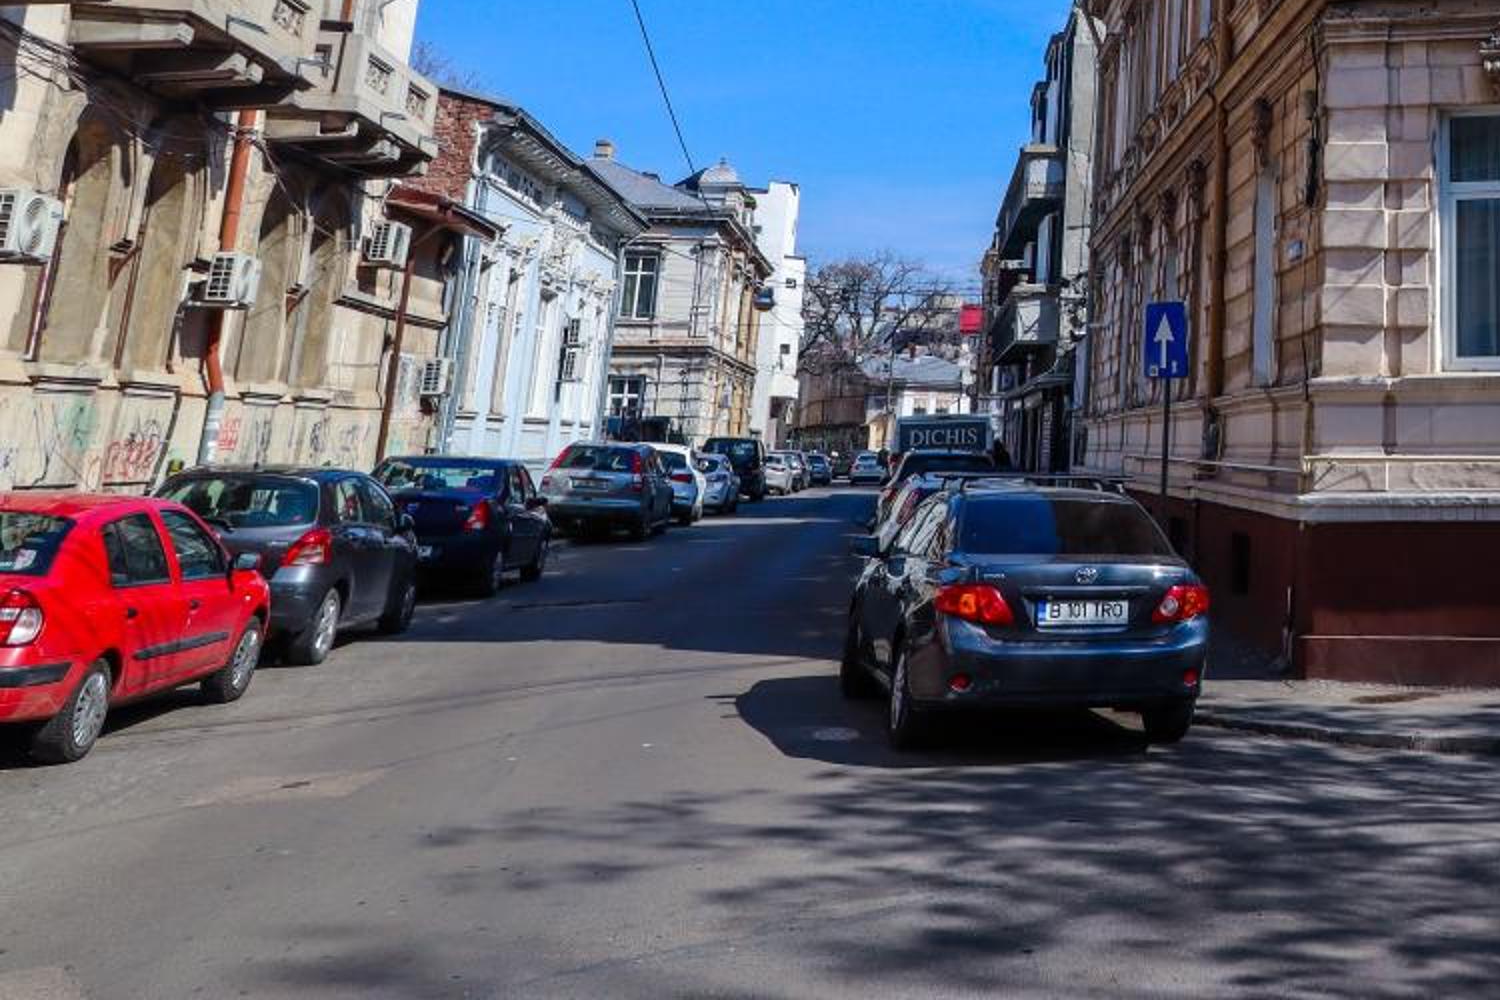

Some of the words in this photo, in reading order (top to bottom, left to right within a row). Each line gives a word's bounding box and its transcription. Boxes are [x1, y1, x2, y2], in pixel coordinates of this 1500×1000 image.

[910, 428, 977, 445] DICHIS
[1050, 602, 1060, 618] B
[1069, 602, 1087, 618] 101
